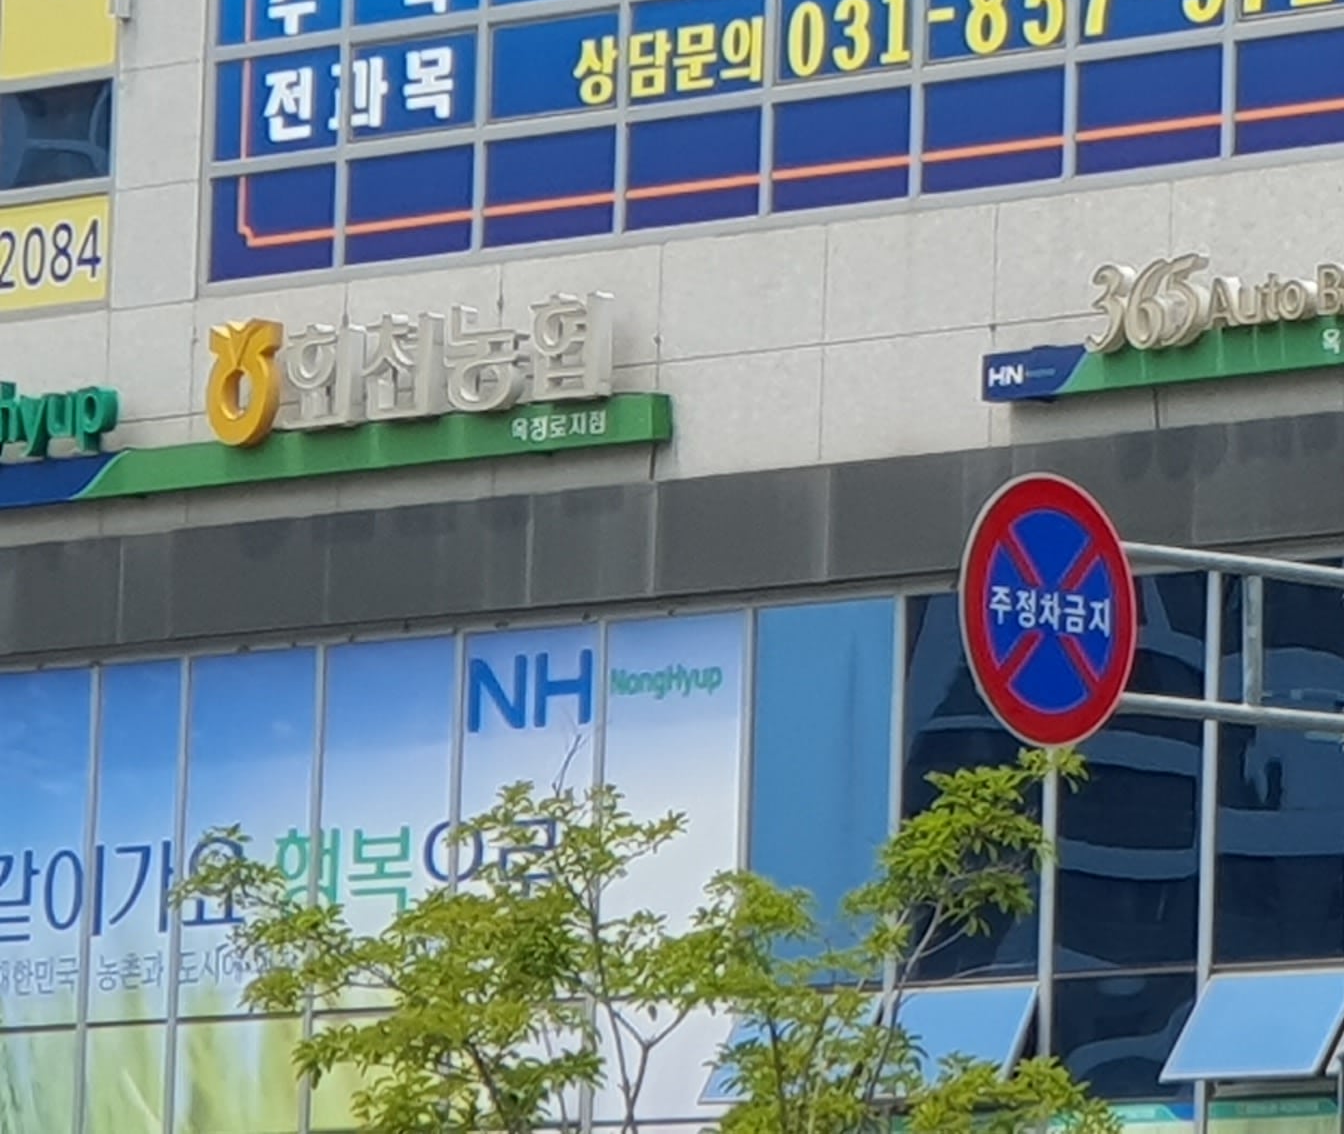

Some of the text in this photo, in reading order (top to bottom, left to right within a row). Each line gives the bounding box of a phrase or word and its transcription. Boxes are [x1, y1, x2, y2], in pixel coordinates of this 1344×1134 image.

[263, 46, 455, 144] 전과목
[573, 15, 765, 107] 상담문의
[1085, 252, 1210, 353] 365
[988, 364, 1023, 387] HN
[511, 409, 607, 442] 옥정로지점
[989, 585, 1110, 638] 주정차금지
[467, 648, 723, 733] NH NongHyup
